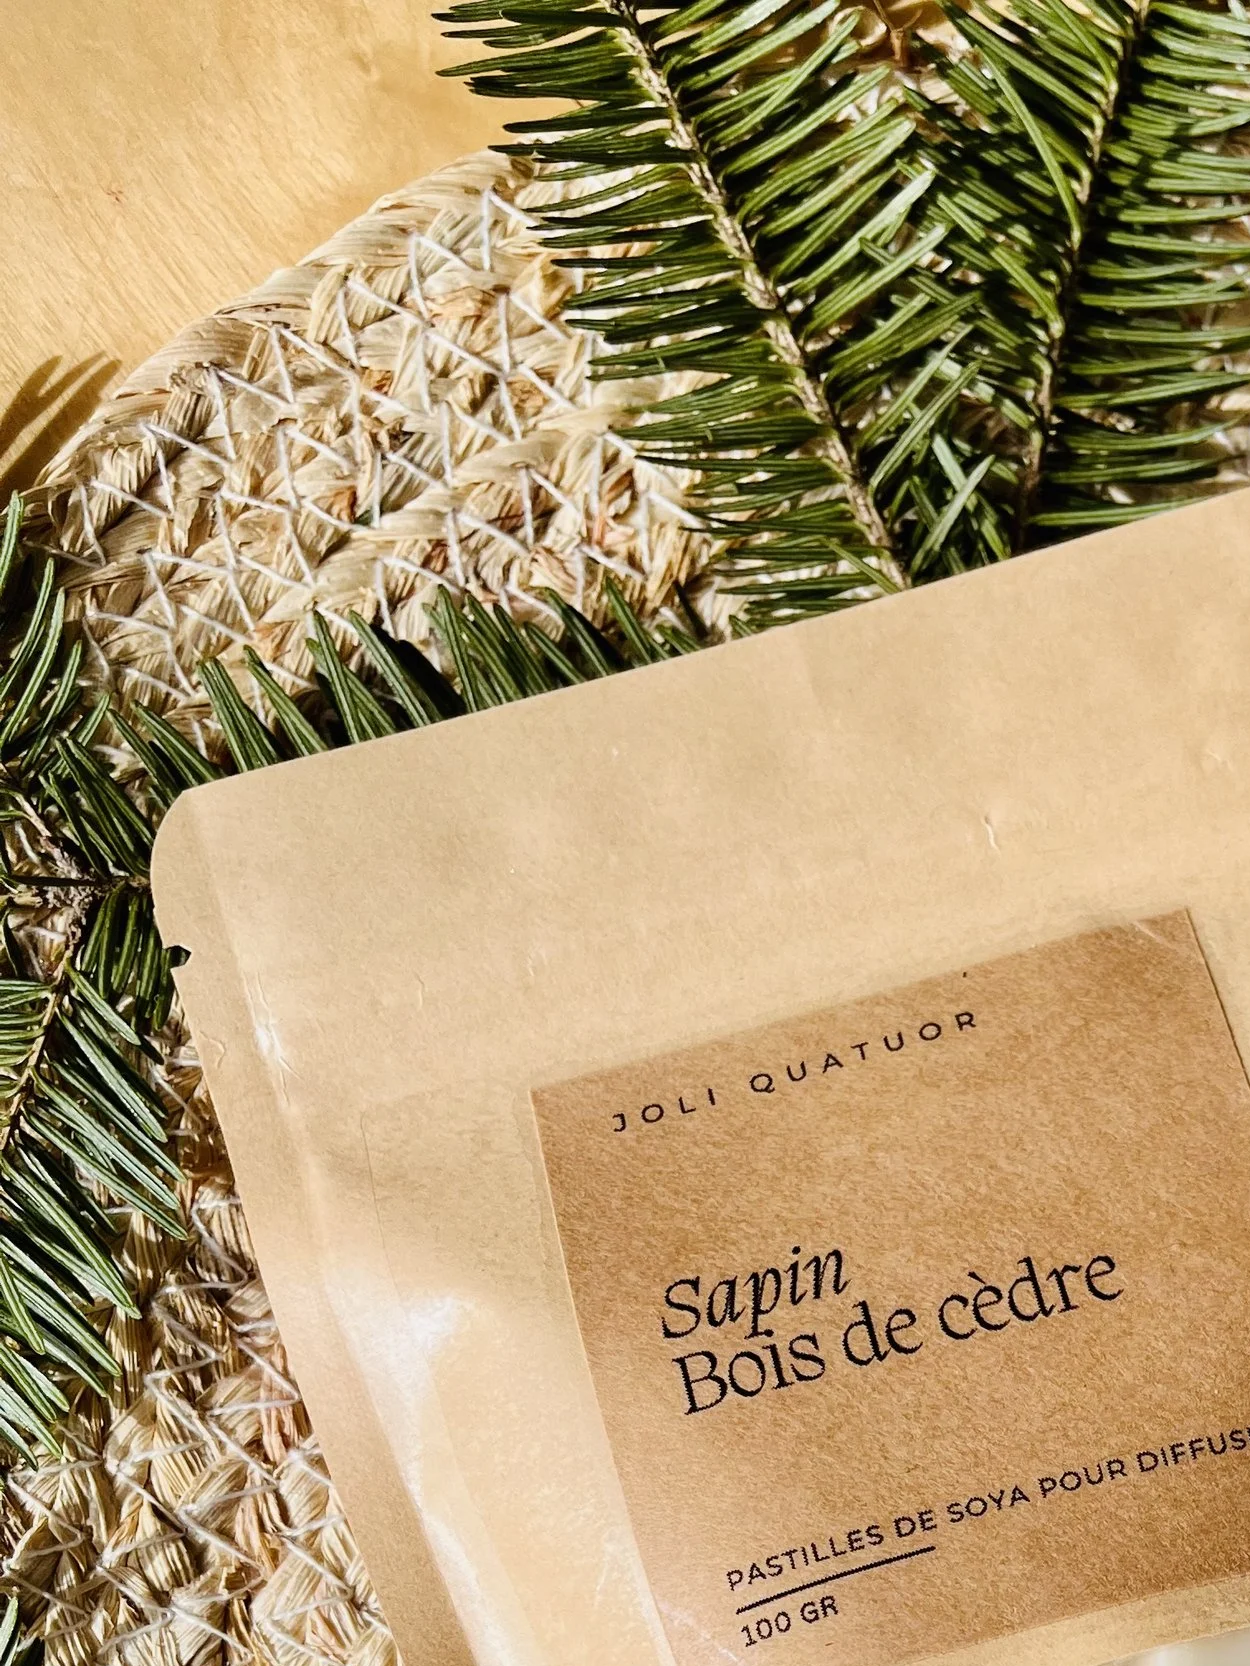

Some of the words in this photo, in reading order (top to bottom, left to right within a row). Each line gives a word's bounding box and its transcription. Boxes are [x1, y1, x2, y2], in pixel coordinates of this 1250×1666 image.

[612, 1088, 716, 1133] JOLI
[749, 1011, 977, 1094] QUATUOR
[661, 1245, 849, 1340] Sapin
[672, 1329, 826, 1415] Bois
[841, 1300, 924, 1367] de
[937, 1253, 1126, 1340] cèdre
[726, 1524, 885, 1591] PASTILLES
[893, 1508, 938, 1538] DE
[946, 1485, 1031, 1523] SOYA
[1037, 1457, 1127, 1498] POUR
[740, 1611, 793, 1648] 100
[799, 1595, 840, 1624] GR
